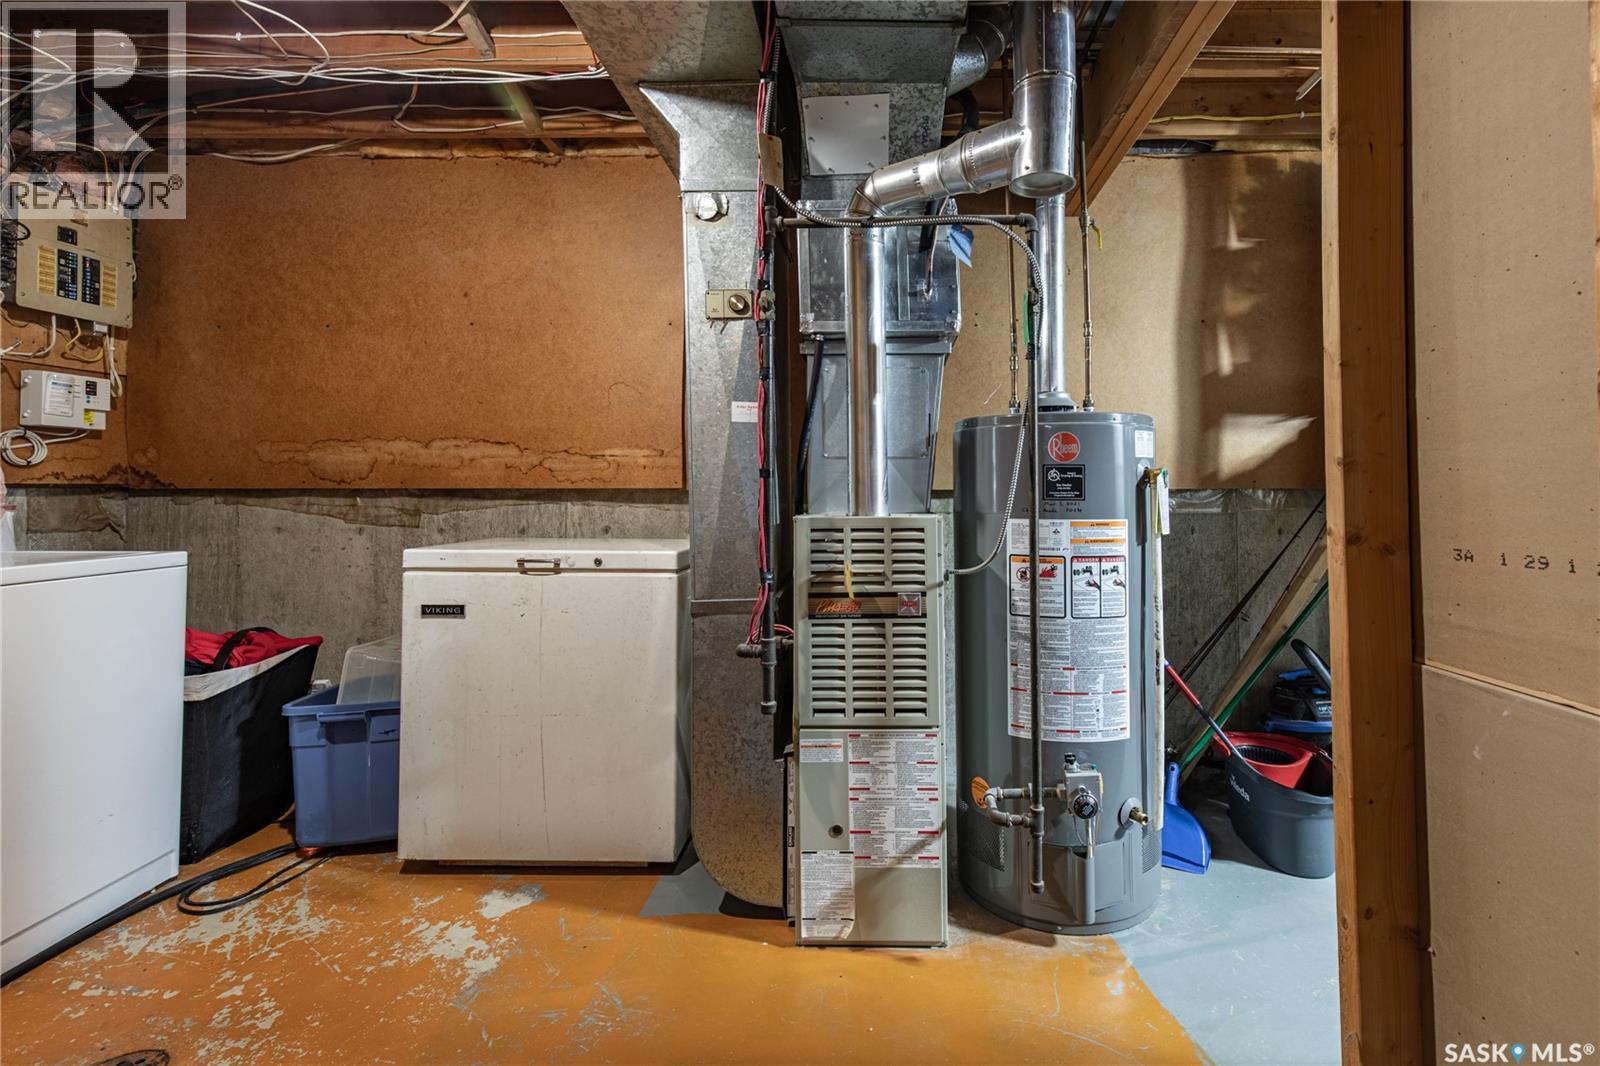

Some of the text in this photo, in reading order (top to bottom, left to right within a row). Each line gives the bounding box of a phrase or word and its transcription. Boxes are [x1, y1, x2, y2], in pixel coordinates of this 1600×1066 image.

[1053, 434, 1079, 458] Rheem
[1453, 548, 1474, 563] 3A
[1524, 554, 1550, 570] 29
[424, 606, 462, 615] VIKING
